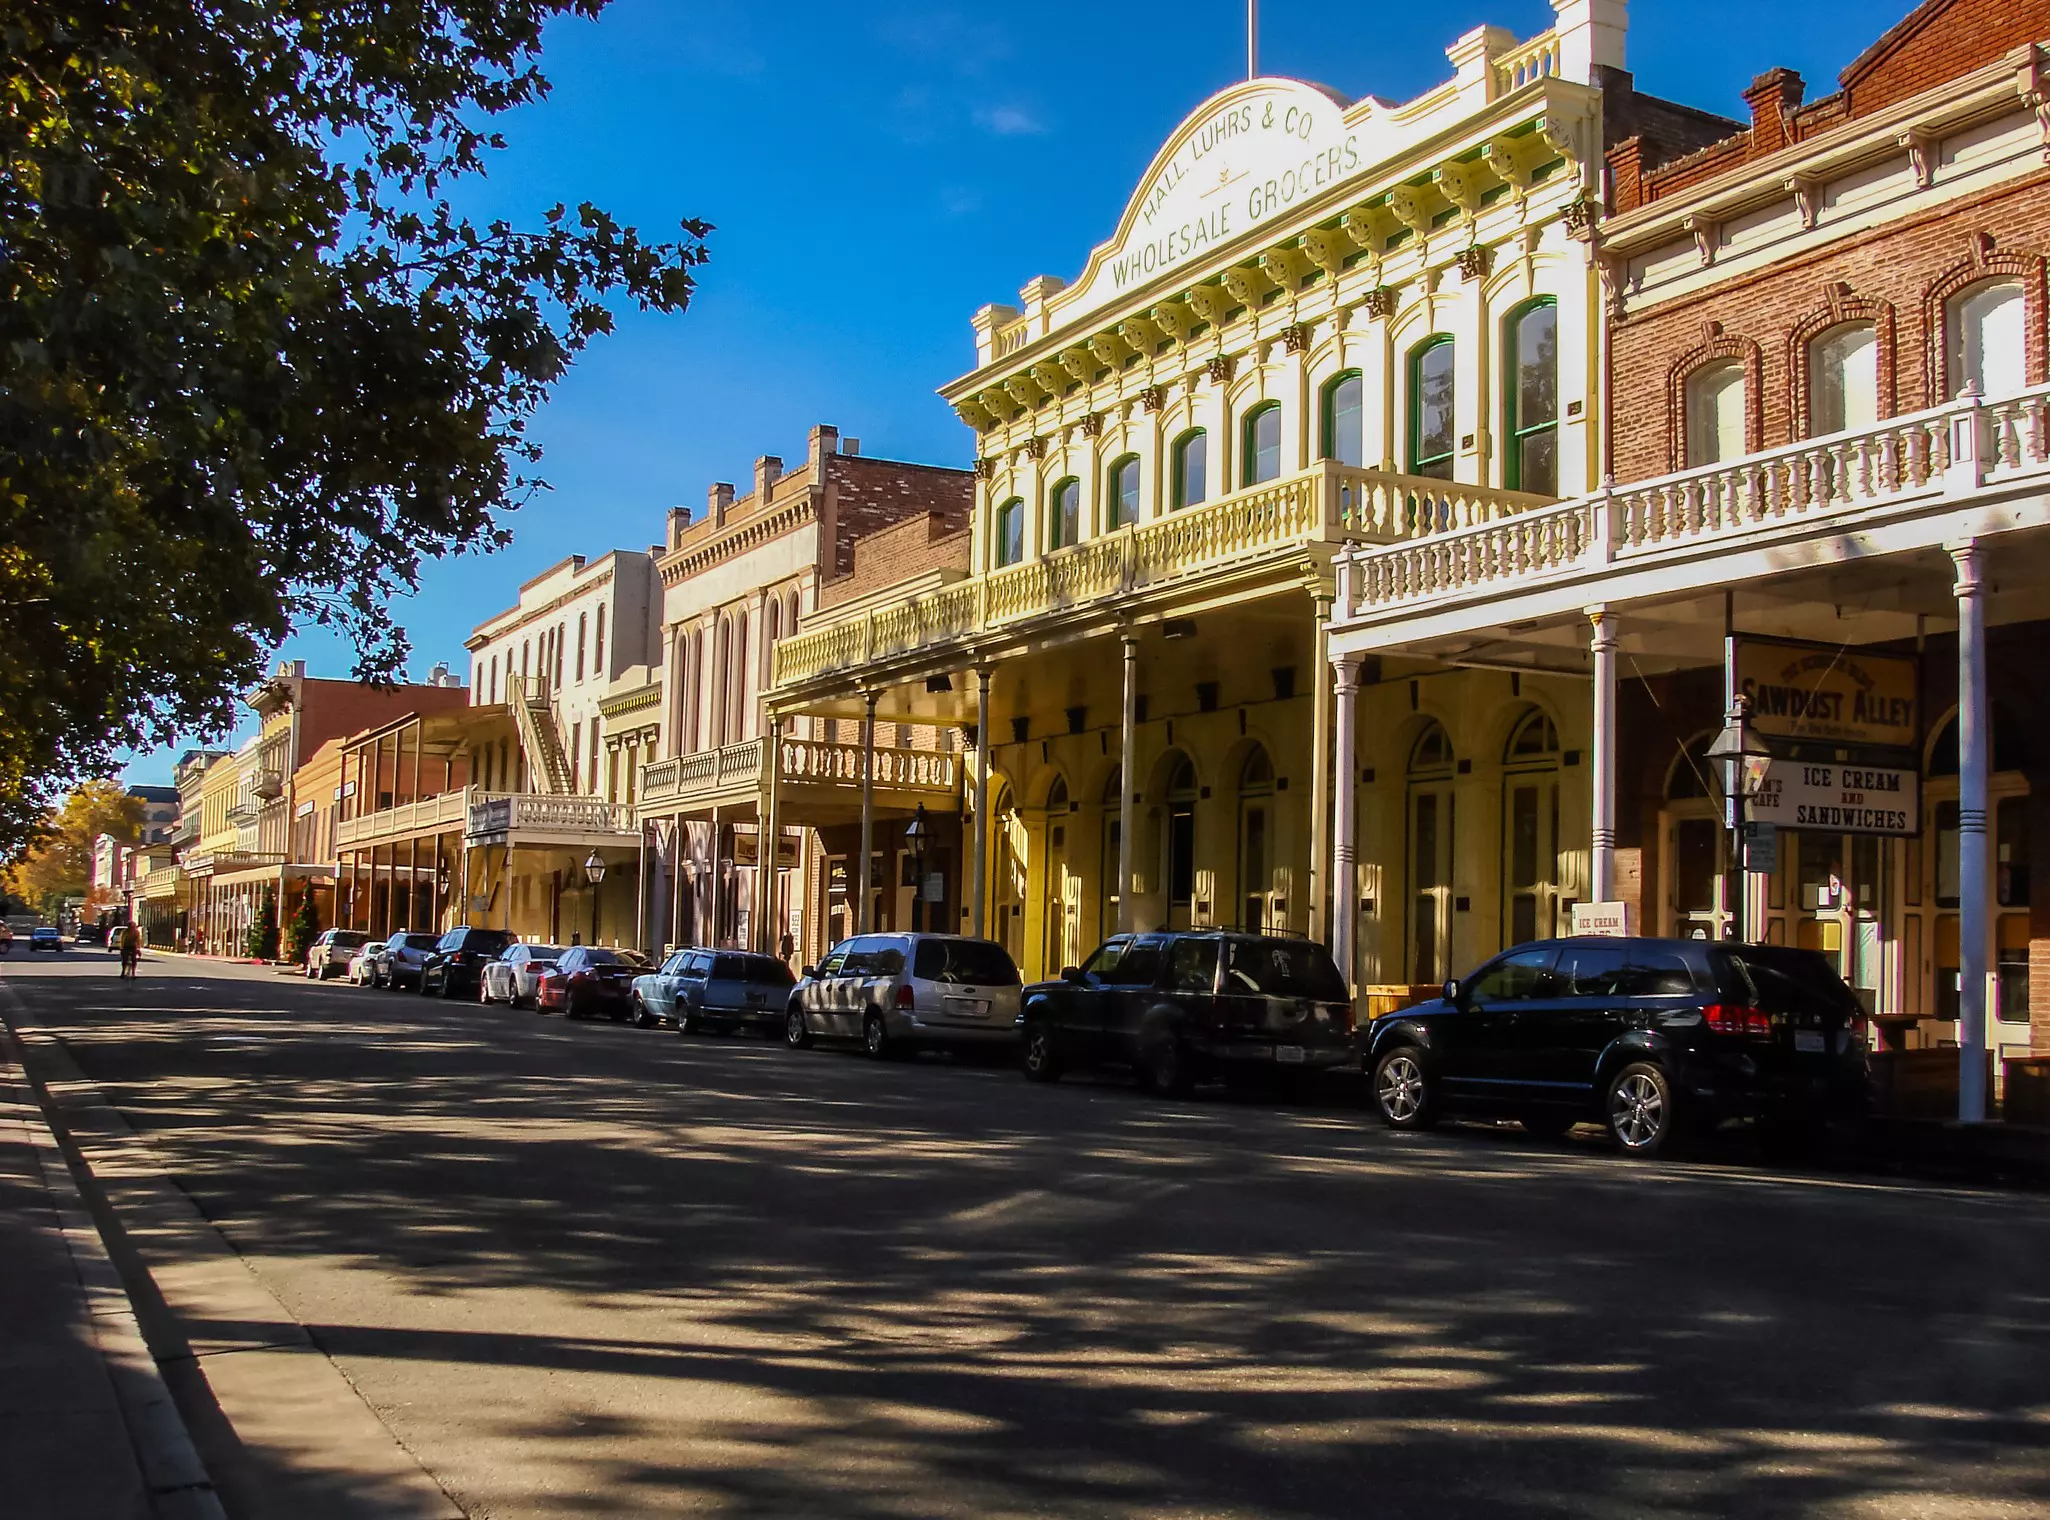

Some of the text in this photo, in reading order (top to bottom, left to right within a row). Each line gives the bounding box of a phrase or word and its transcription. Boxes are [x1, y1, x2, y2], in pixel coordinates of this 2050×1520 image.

[1191, 105, 1251, 161] LUHRS
[1261, 100, 1275, 130] &
[1112, 202, 1232, 290] WHOLESALE
[1742, 677, 1914, 727] SAWDUST ALLEY
[1803, 767, 1900, 791] ICE CREAM
[1752, 793, 1780, 808] CAFE
[1841, 792, 1864, 805] AND
[1796, 805, 1907, 830] SANDWICHES
[1579, 917, 1619, 928] ICE CREAM
